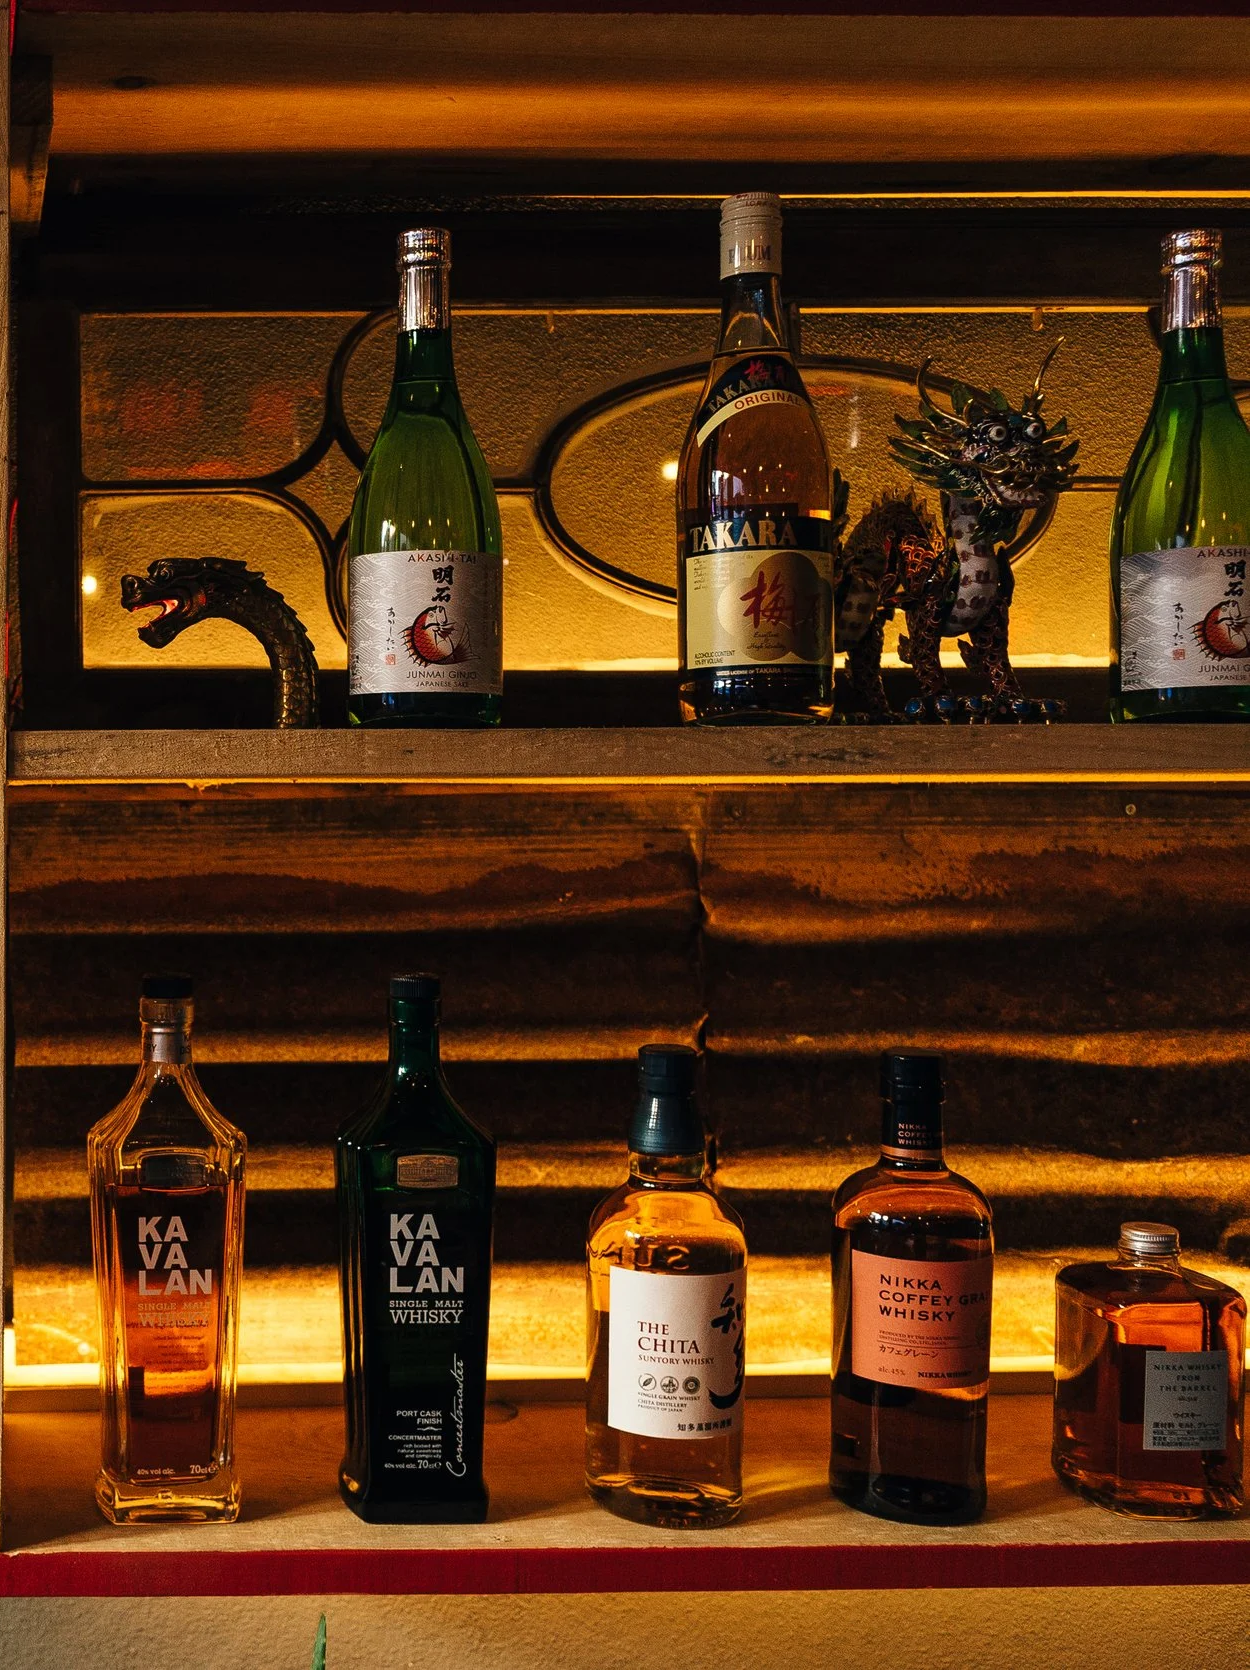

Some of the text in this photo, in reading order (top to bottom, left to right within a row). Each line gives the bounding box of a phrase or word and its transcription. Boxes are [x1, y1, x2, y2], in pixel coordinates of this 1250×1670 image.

[734, 391, 803, 410] ORIGINAL
[690, 519, 798, 553] TAKARA
[432, 564, 454, 603] 明石
[1224, 559, 1246, 597] 明石
[406, 670, 477, 680] JUNMAI GINJO
[1198, 664, 1240, 673] JUNMAI
[416, 680, 452, 688] JAPANESE
[138, 1216, 189, 1242] KA
[390, 1213, 440, 1240] KA
[138, 1243, 188, 1270] VA
[390, 1240, 440, 1267] VA
[138, 1269, 212, 1296] LAN
[389, 1266, 464, 1293] LAN
[880, 1273, 943, 1291] NIKKA
[137, 1302, 211, 1311] SINGLE MALT
[389, 1300, 464, 1308] SINGLE MALT
[879, 1290, 989, 1307] COFFEY GRA
[138, 1311, 210, 1327] WHISKY
[389, 1309, 463, 1324] WHISKY
[878, 1304, 956, 1322] WHISKY
[637, 1320, 670, 1335] THE
[638, 1336, 700, 1354] CHITA
[879, 1344, 939, 1359] カフェグレーン
[638, 1354, 715, 1365] SUNTORY WHISKY
[656, 1400, 687, 1408] DISTILLERY
[416, 1417, 443, 1425] FINISH
[446, 1353, 467, 1477] Concertmaster
[150, 1467, 161, 1475] vol
